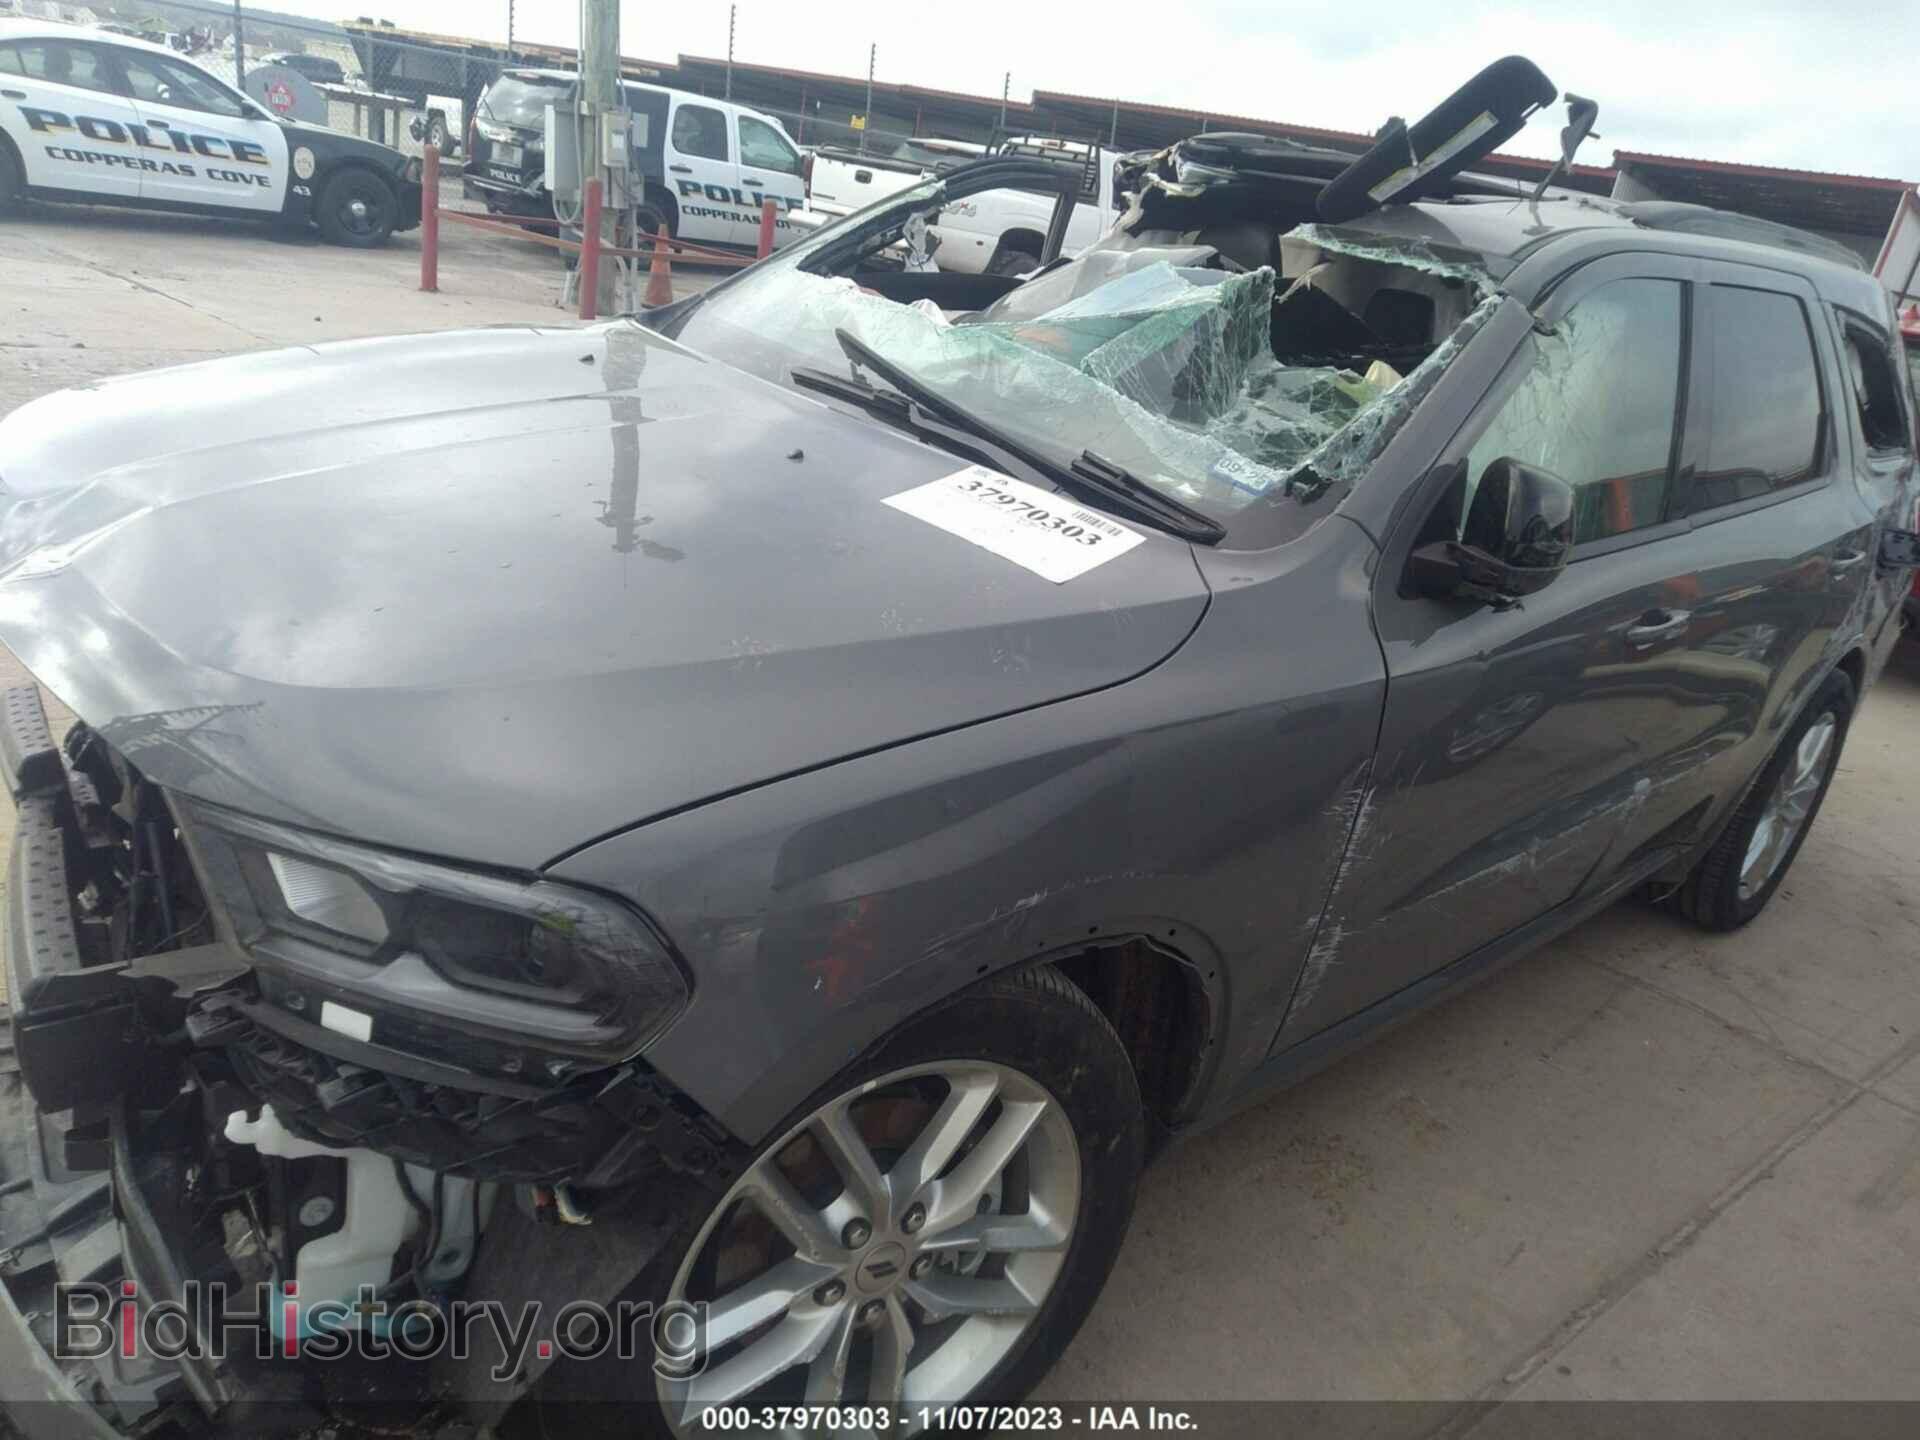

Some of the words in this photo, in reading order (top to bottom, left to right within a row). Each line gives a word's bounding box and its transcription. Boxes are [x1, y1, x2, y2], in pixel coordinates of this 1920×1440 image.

[17, 106, 271, 167] POLICE
[45, 146, 196, 177] COPPERAS
[206, 167, 272, 188] COVE
[681, 205, 761, 225] COPPERAS
[957, 480, 1102, 546] 37970303
